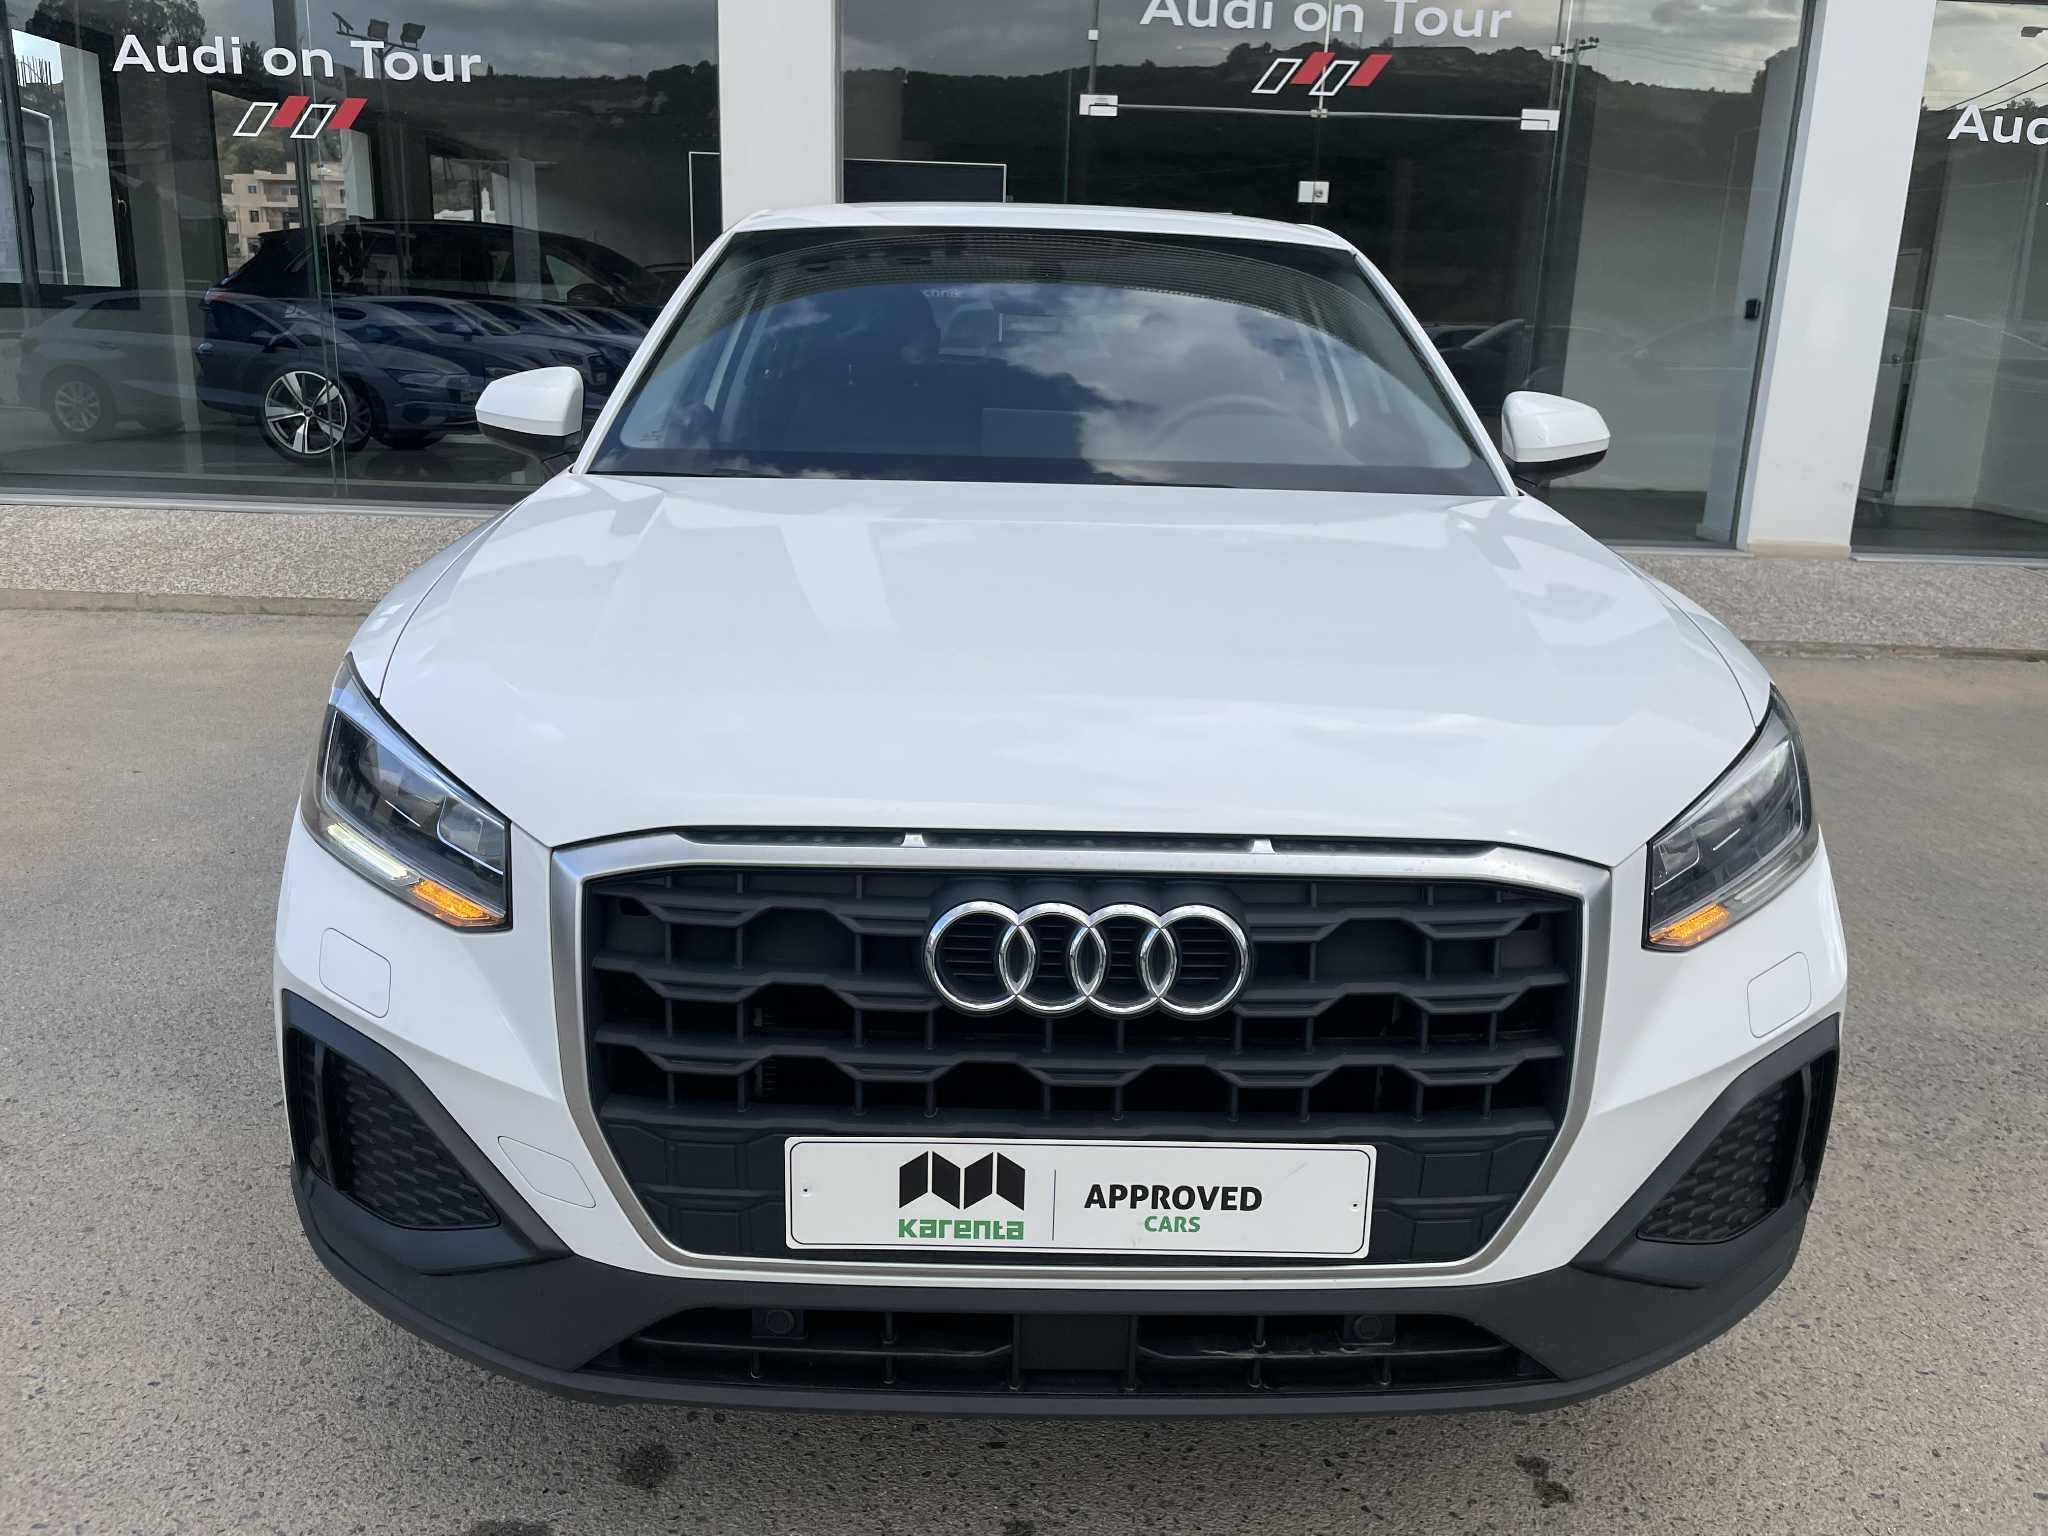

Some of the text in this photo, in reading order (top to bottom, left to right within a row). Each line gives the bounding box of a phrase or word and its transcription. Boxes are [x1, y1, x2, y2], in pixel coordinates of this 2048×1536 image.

[1139, 0, 1513, 38] Audi on Tour
[112, 34, 482, 82] Audi on Tour
[1084, 1184, 1263, 1211] APPROVED
[1144, 1216, 1201, 1232] CARS
